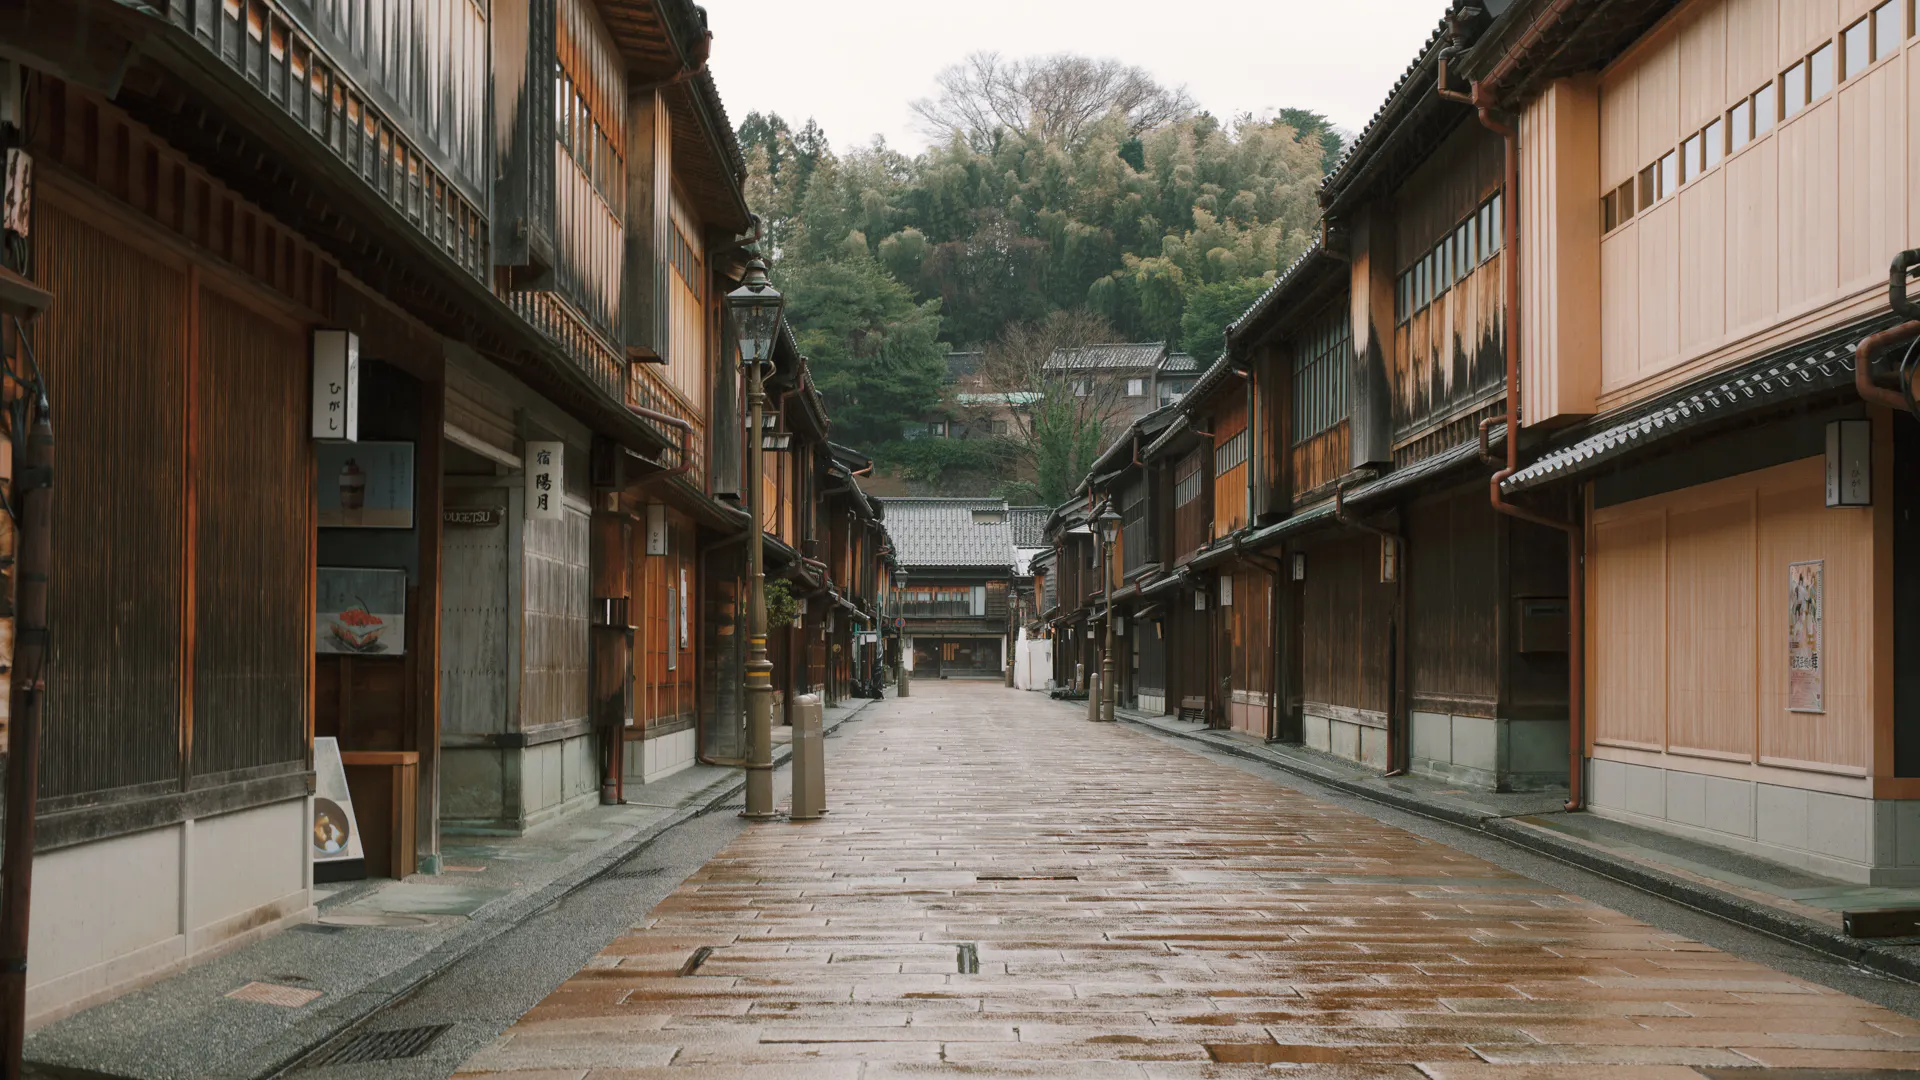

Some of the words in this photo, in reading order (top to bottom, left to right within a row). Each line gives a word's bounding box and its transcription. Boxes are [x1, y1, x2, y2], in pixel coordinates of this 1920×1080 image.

[329, 382, 342, 431] ひがし
[1851, 469, 1861, 499] ひがし
[443, 511, 490, 523] OUGETSU
